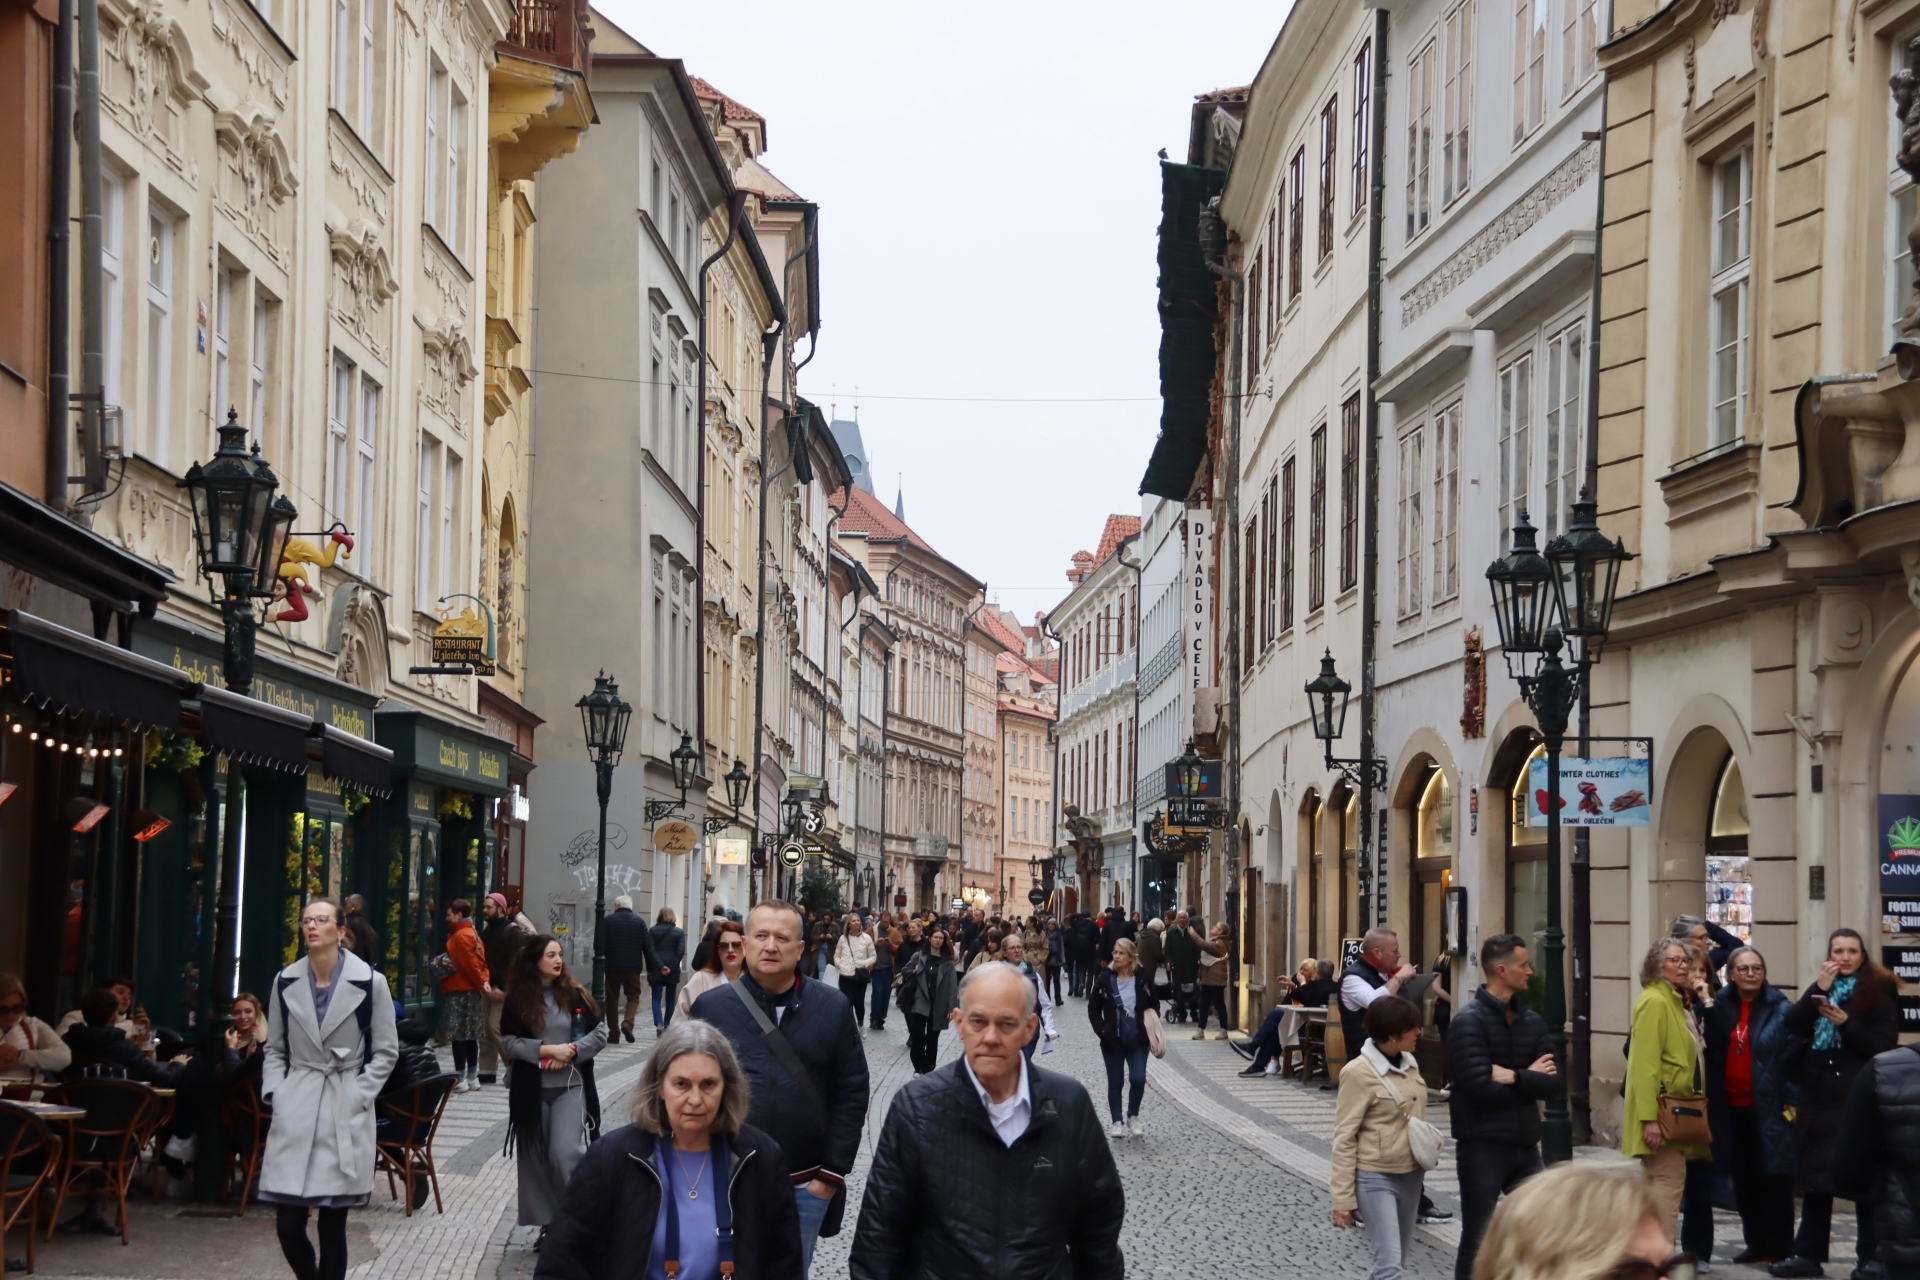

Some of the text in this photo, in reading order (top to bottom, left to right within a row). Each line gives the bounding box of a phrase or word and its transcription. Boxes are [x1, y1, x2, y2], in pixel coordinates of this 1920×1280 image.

[1194, 522, 1204, 614] DIVADLO
[434, 639, 481, 649] RESTAURANT
[433, 650, 439, 660] U
[468, 651, 480, 660] lva
[332, 704, 365, 738] Pohádka
[440, 739, 456, 768] Czech
[478, 750, 500, 779] Pohádka
[1559, 770, 1620, 778] INTER CLOTHES
[1562, 816, 1615, 825] ZIMNÍ OBLEČENÍ
[664, 823, 687, 833] Made
[670, 834, 681, 844] by
[661, 841, 687, 852] Praha
[1893, 966, 1920, 977] PRAG
